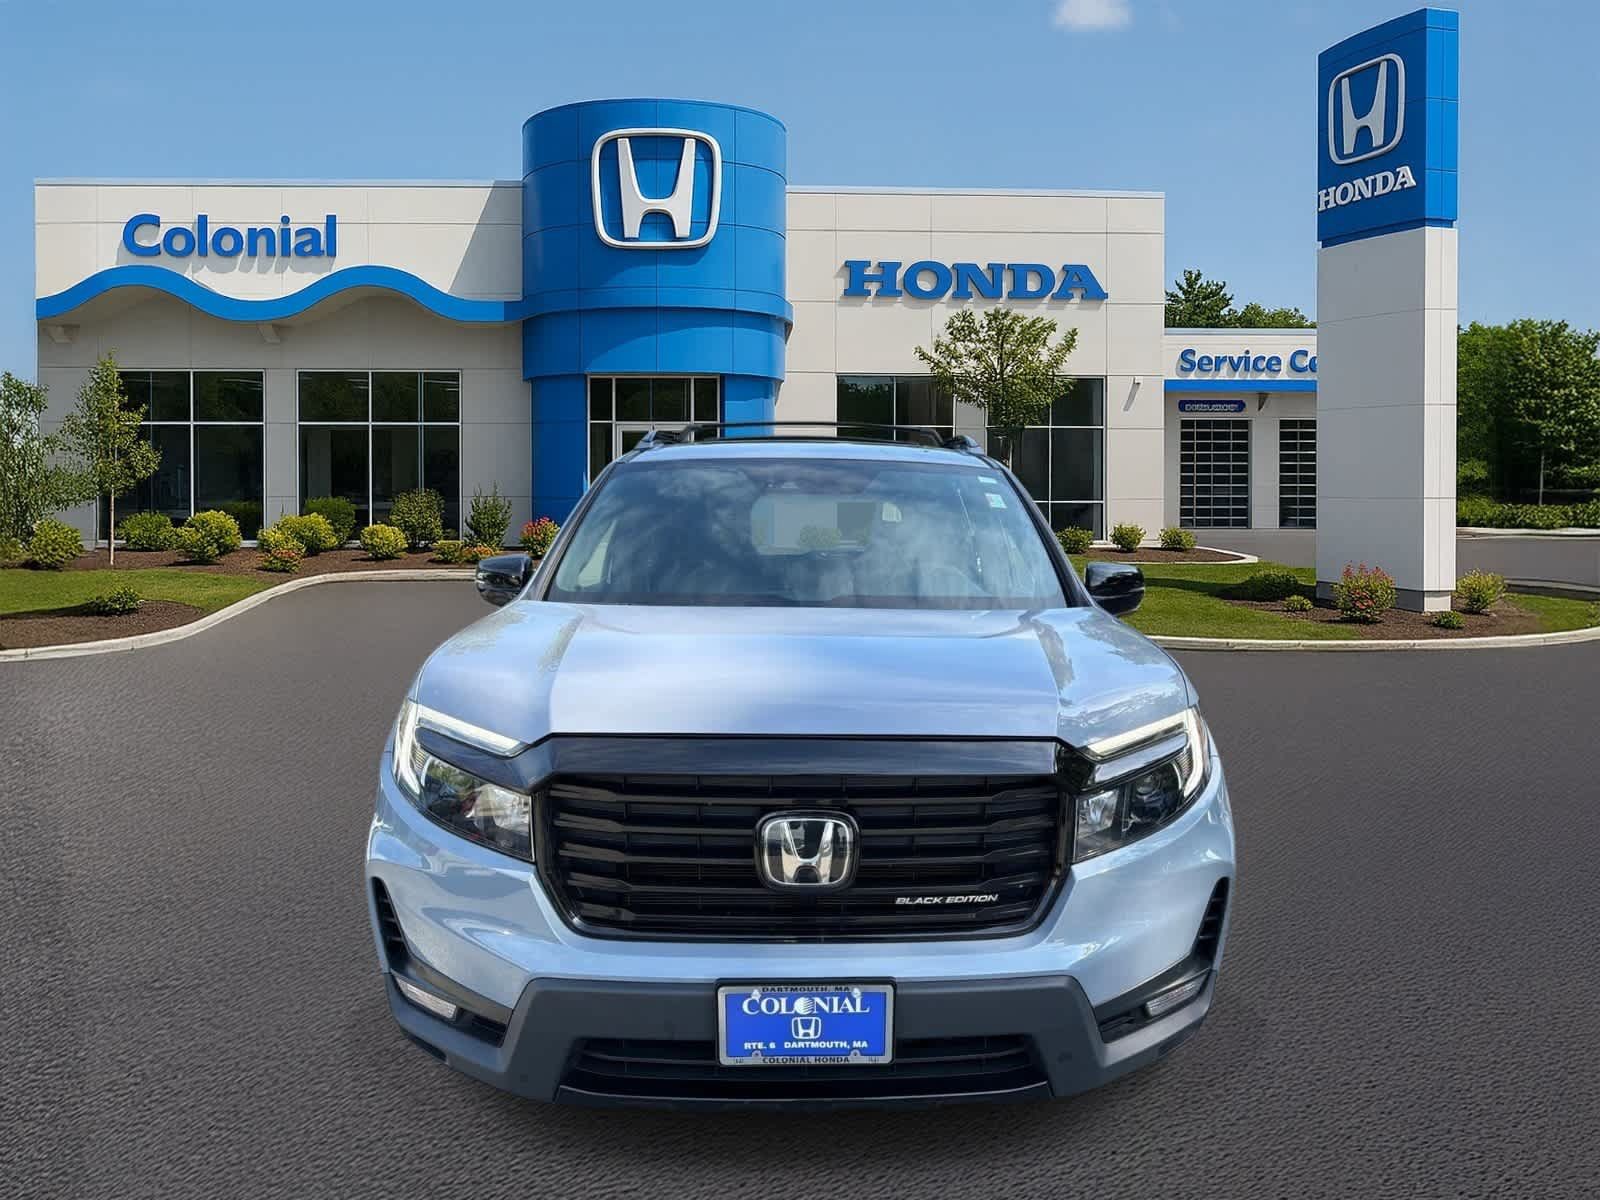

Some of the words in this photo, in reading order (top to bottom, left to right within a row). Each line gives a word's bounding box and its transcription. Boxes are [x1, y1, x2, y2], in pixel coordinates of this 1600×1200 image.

[1318, 165, 1417, 212] HONDA
[122, 213, 337, 258] Colonial
[843, 260, 1109, 300] HONDA
[1180, 349, 1281, 373] Service
[895, 897, 943, 905] BLACK
[945, 894, 999, 904] EDITION
[742, 996, 870, 1015] COLONIAL
[744, 1042, 767, 1050] RTE.
[784, 1041, 850, 1049] DARTMOUTH,
[852, 1040, 868, 1048] MA
[762, 1056, 811, 1064] COLONIAL
